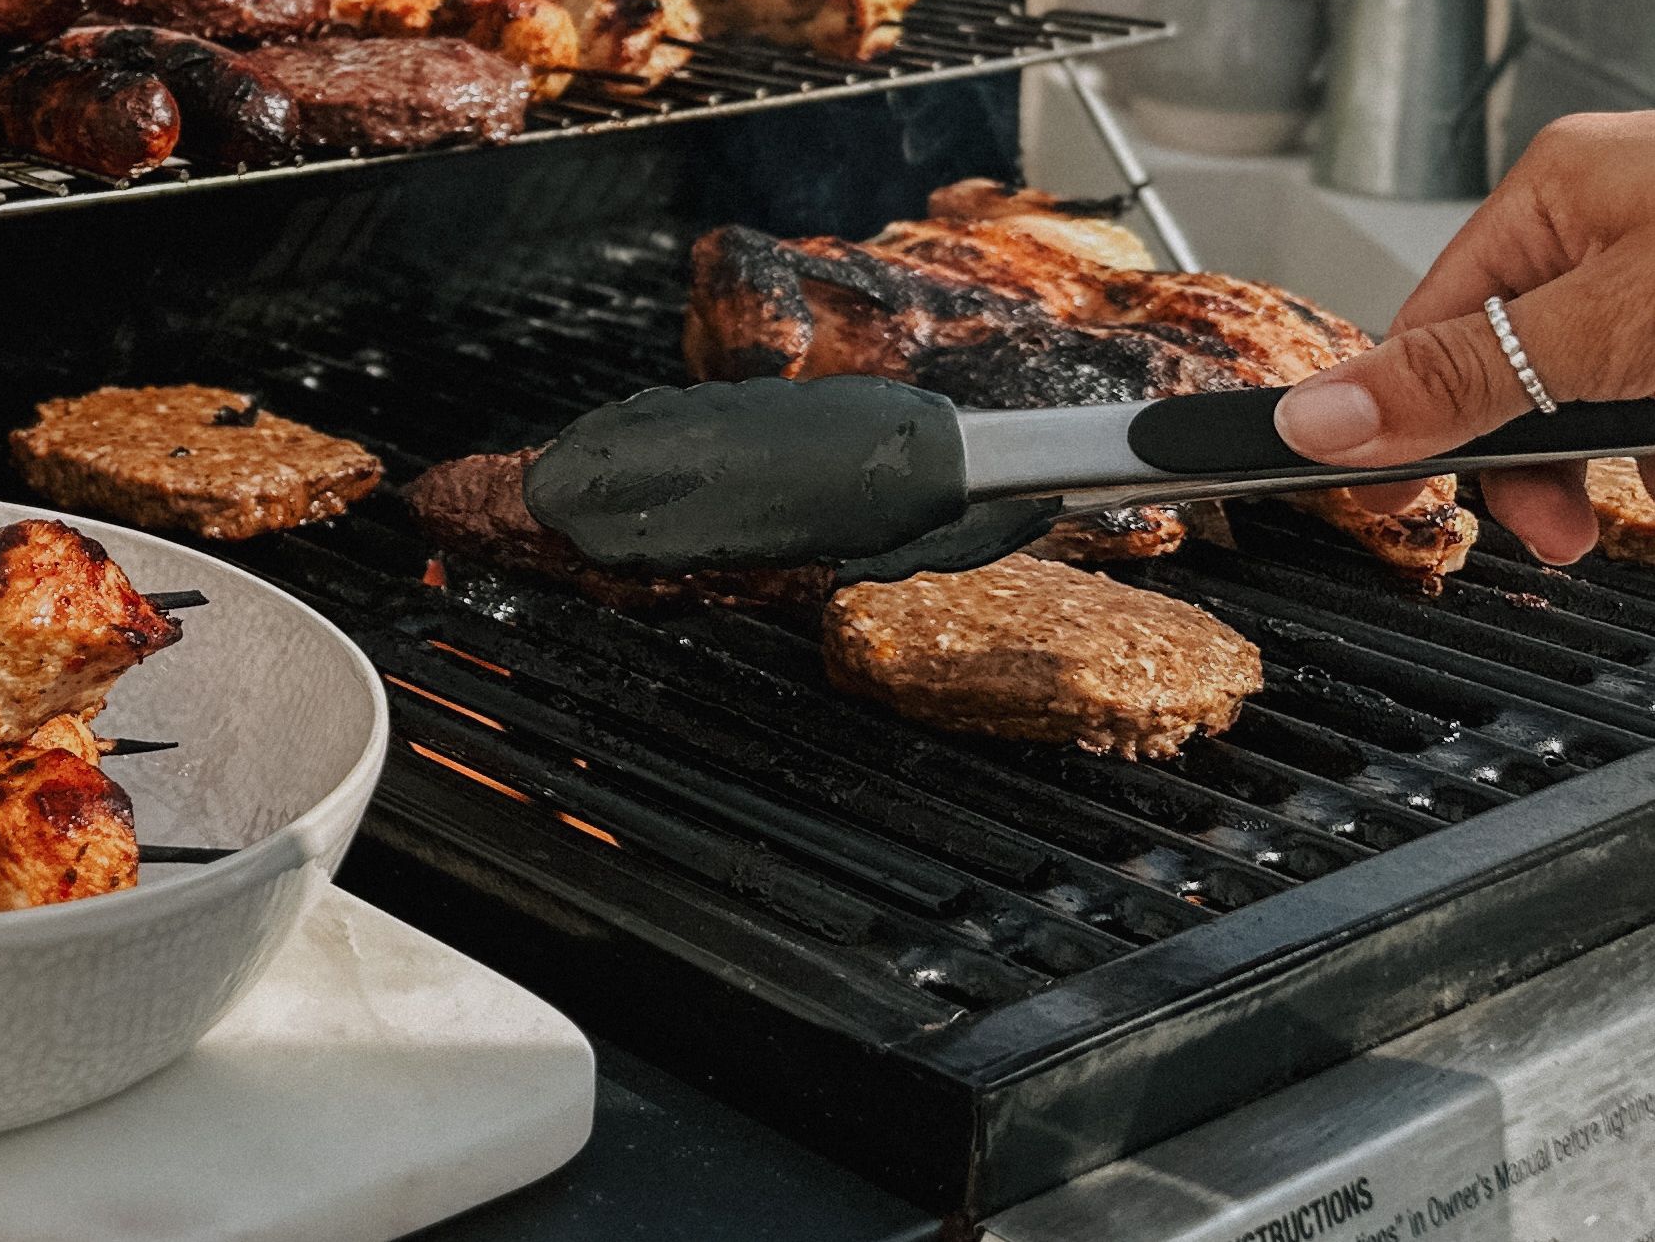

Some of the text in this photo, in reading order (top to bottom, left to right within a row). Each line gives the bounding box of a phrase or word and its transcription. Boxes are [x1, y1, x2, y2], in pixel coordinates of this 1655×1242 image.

[1407, 1208, 1427, 1238] in
[1428, 1173, 1494, 1228] Owner's
[1494, 1140, 1552, 1191] Manual
